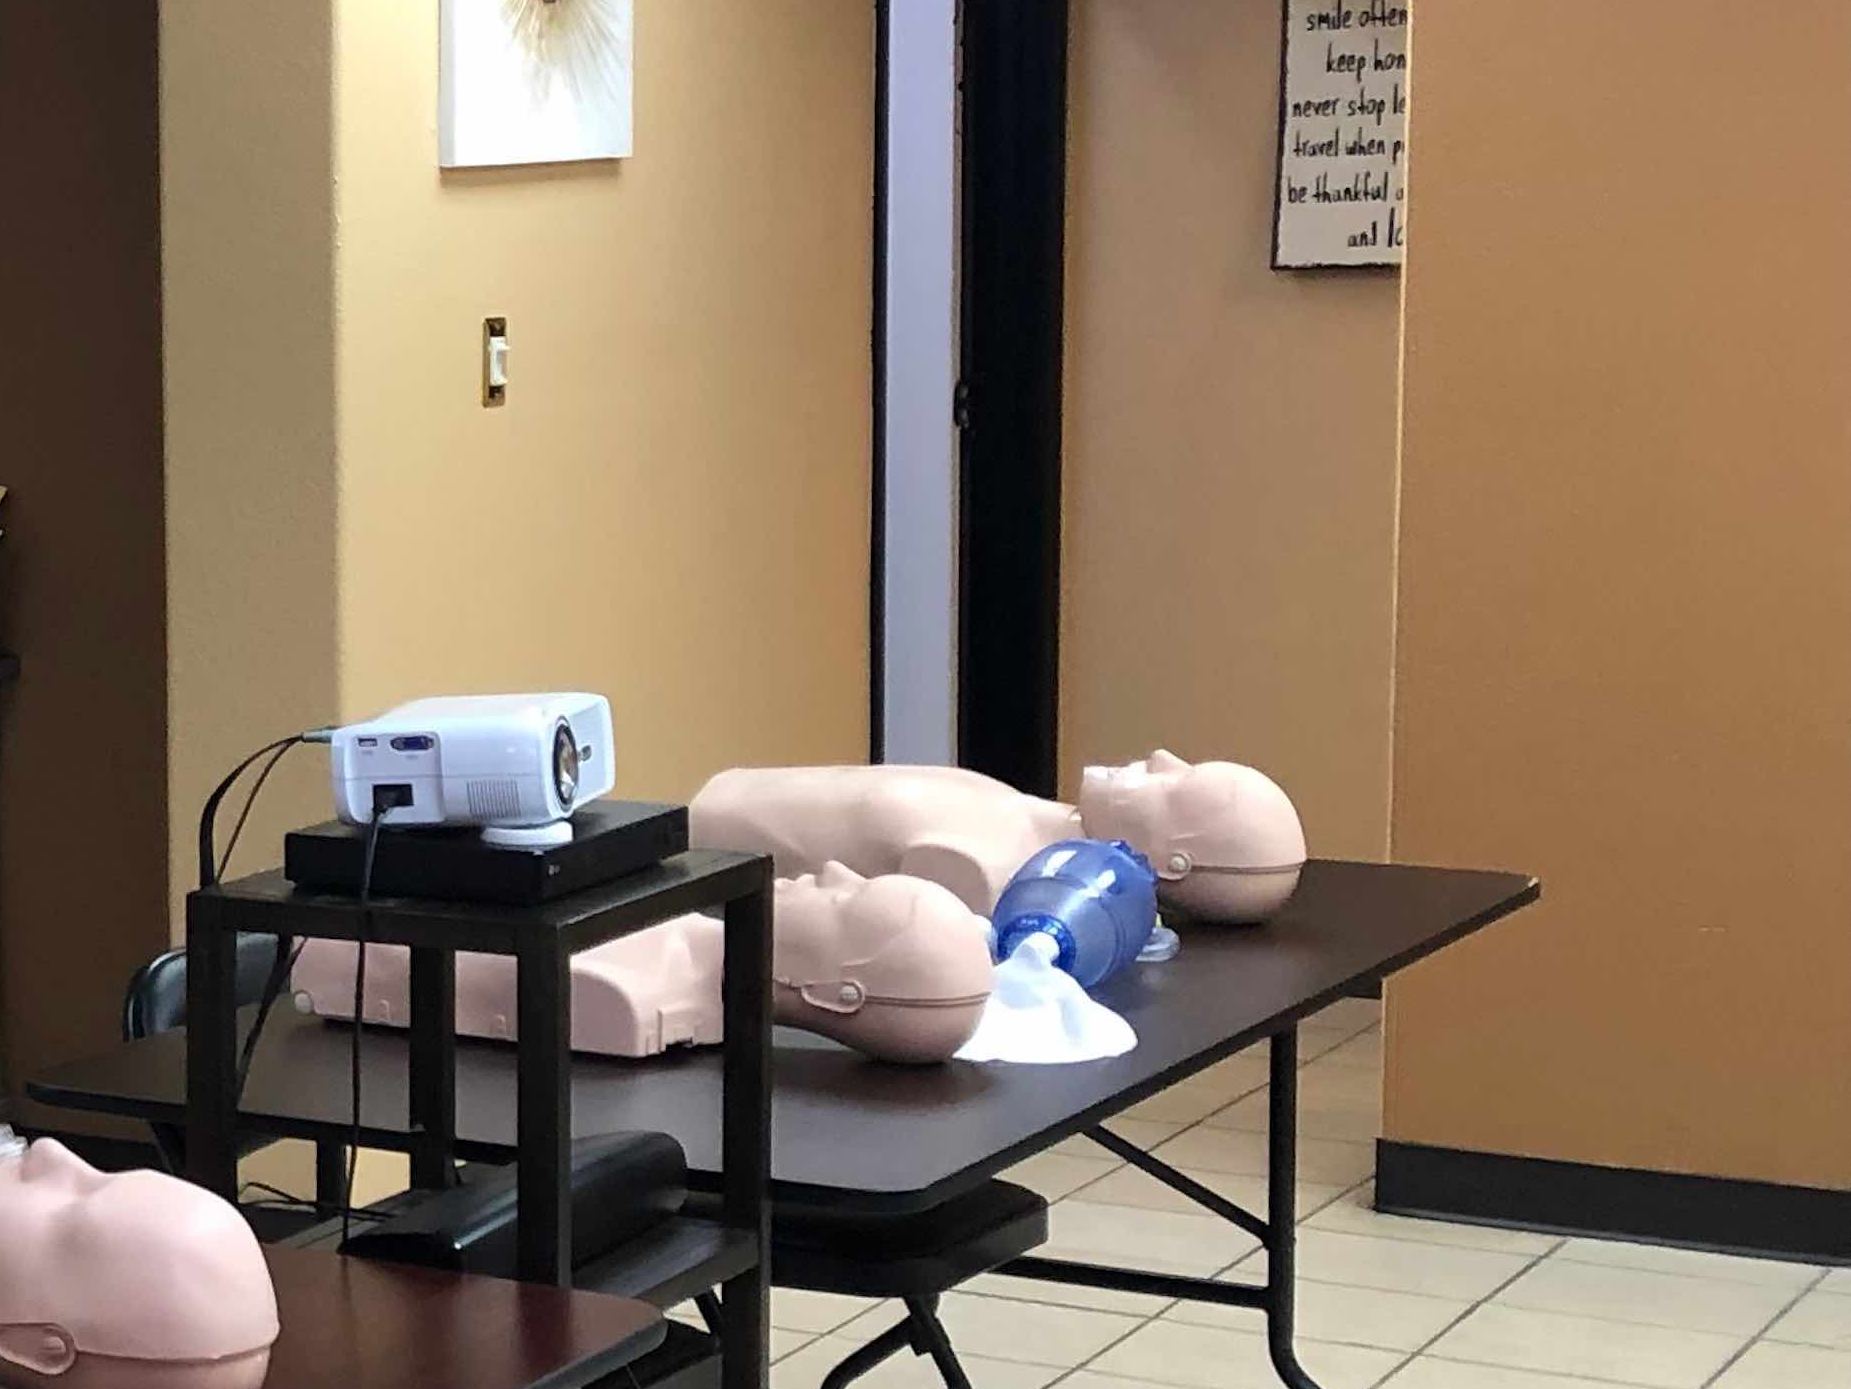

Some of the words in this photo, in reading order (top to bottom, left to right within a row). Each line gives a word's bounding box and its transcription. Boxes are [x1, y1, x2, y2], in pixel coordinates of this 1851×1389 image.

[1326, 41, 1366, 84] keep
[1292, 97, 1340, 118] never
[1347, 86, 1386, 126] stop
[1293, 126, 1340, 157] travel
[1345, 126, 1386, 156] when
[1392, 140, 1405, 165] p
[1287, 175, 1308, 204] be
[1312, 170, 1389, 204] thankful
[1347, 220, 1378, 248] and
